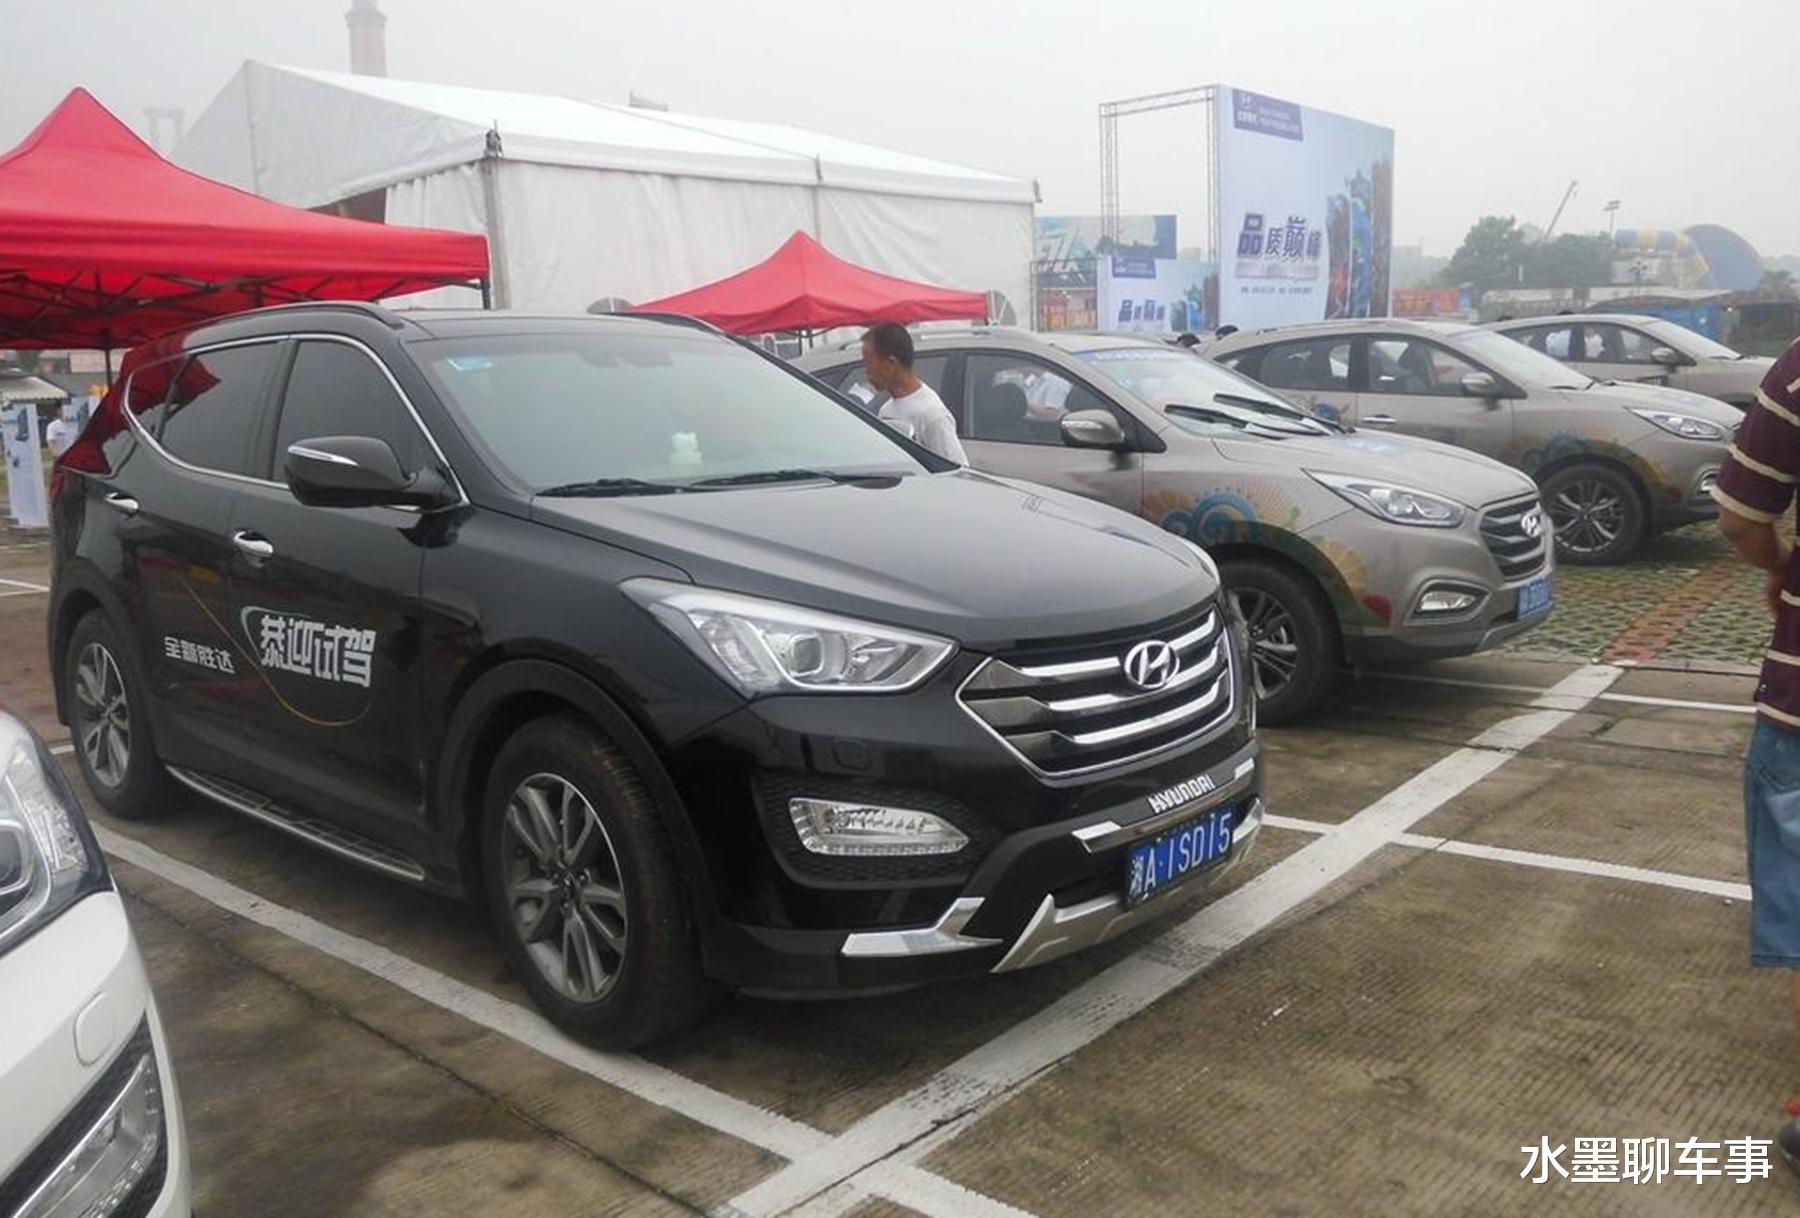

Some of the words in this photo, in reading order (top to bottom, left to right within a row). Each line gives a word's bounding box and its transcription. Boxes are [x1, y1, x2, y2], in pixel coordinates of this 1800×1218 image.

[164, 636, 236, 674] 全新胜达
[260, 614, 376, 688] 恭迎试驾
[1147, 773, 1217, 814] HYUNDAI
